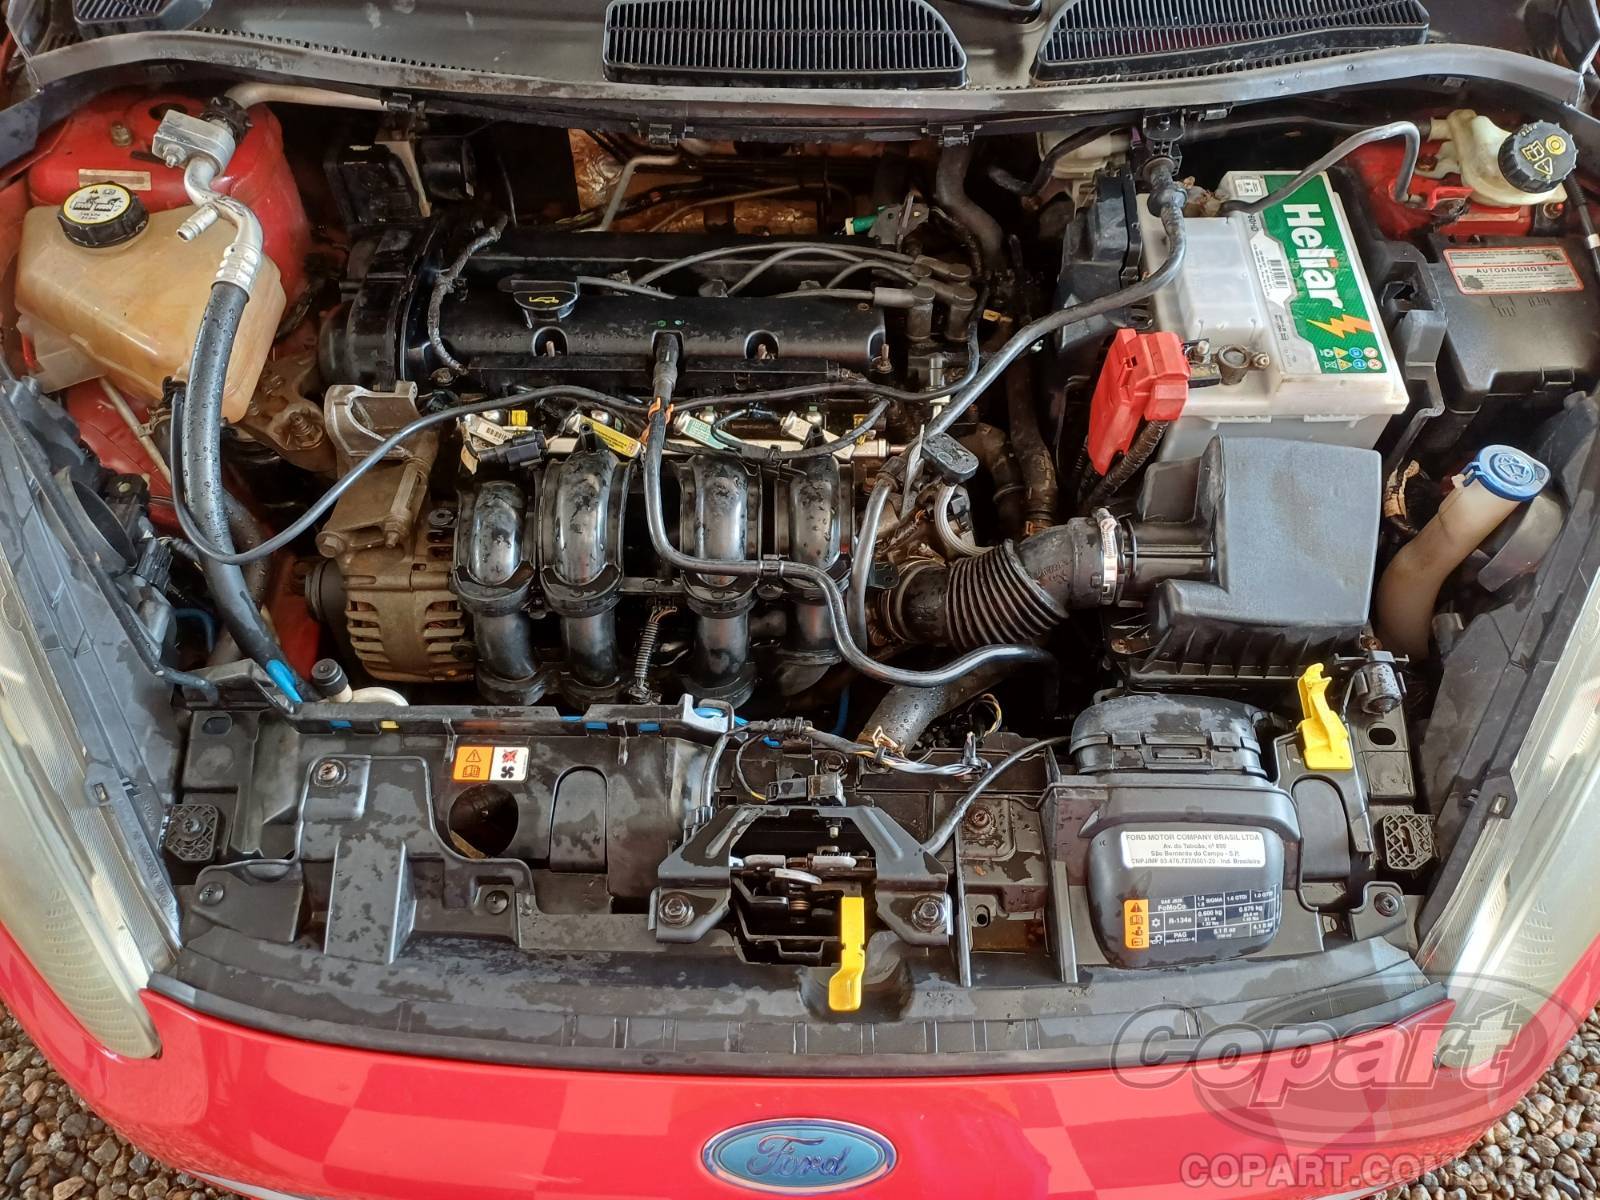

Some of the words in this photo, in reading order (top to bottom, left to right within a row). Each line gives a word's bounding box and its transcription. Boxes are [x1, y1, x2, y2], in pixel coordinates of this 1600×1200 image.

[1282, 203, 1344, 309] Heliar
[1476, 266, 1549, 274] AUTODIAGNOSE
[1126, 833, 1147, 841] FORD
[1148, 833, 1176, 841] MOTOR
[1176, 833, 1212, 841] COMPANY
[1213, 833, 1241, 841] BRASIL
[1158, 902, 1187, 911] FoMoCo
[747, 1135, 851, 1176] Ford
